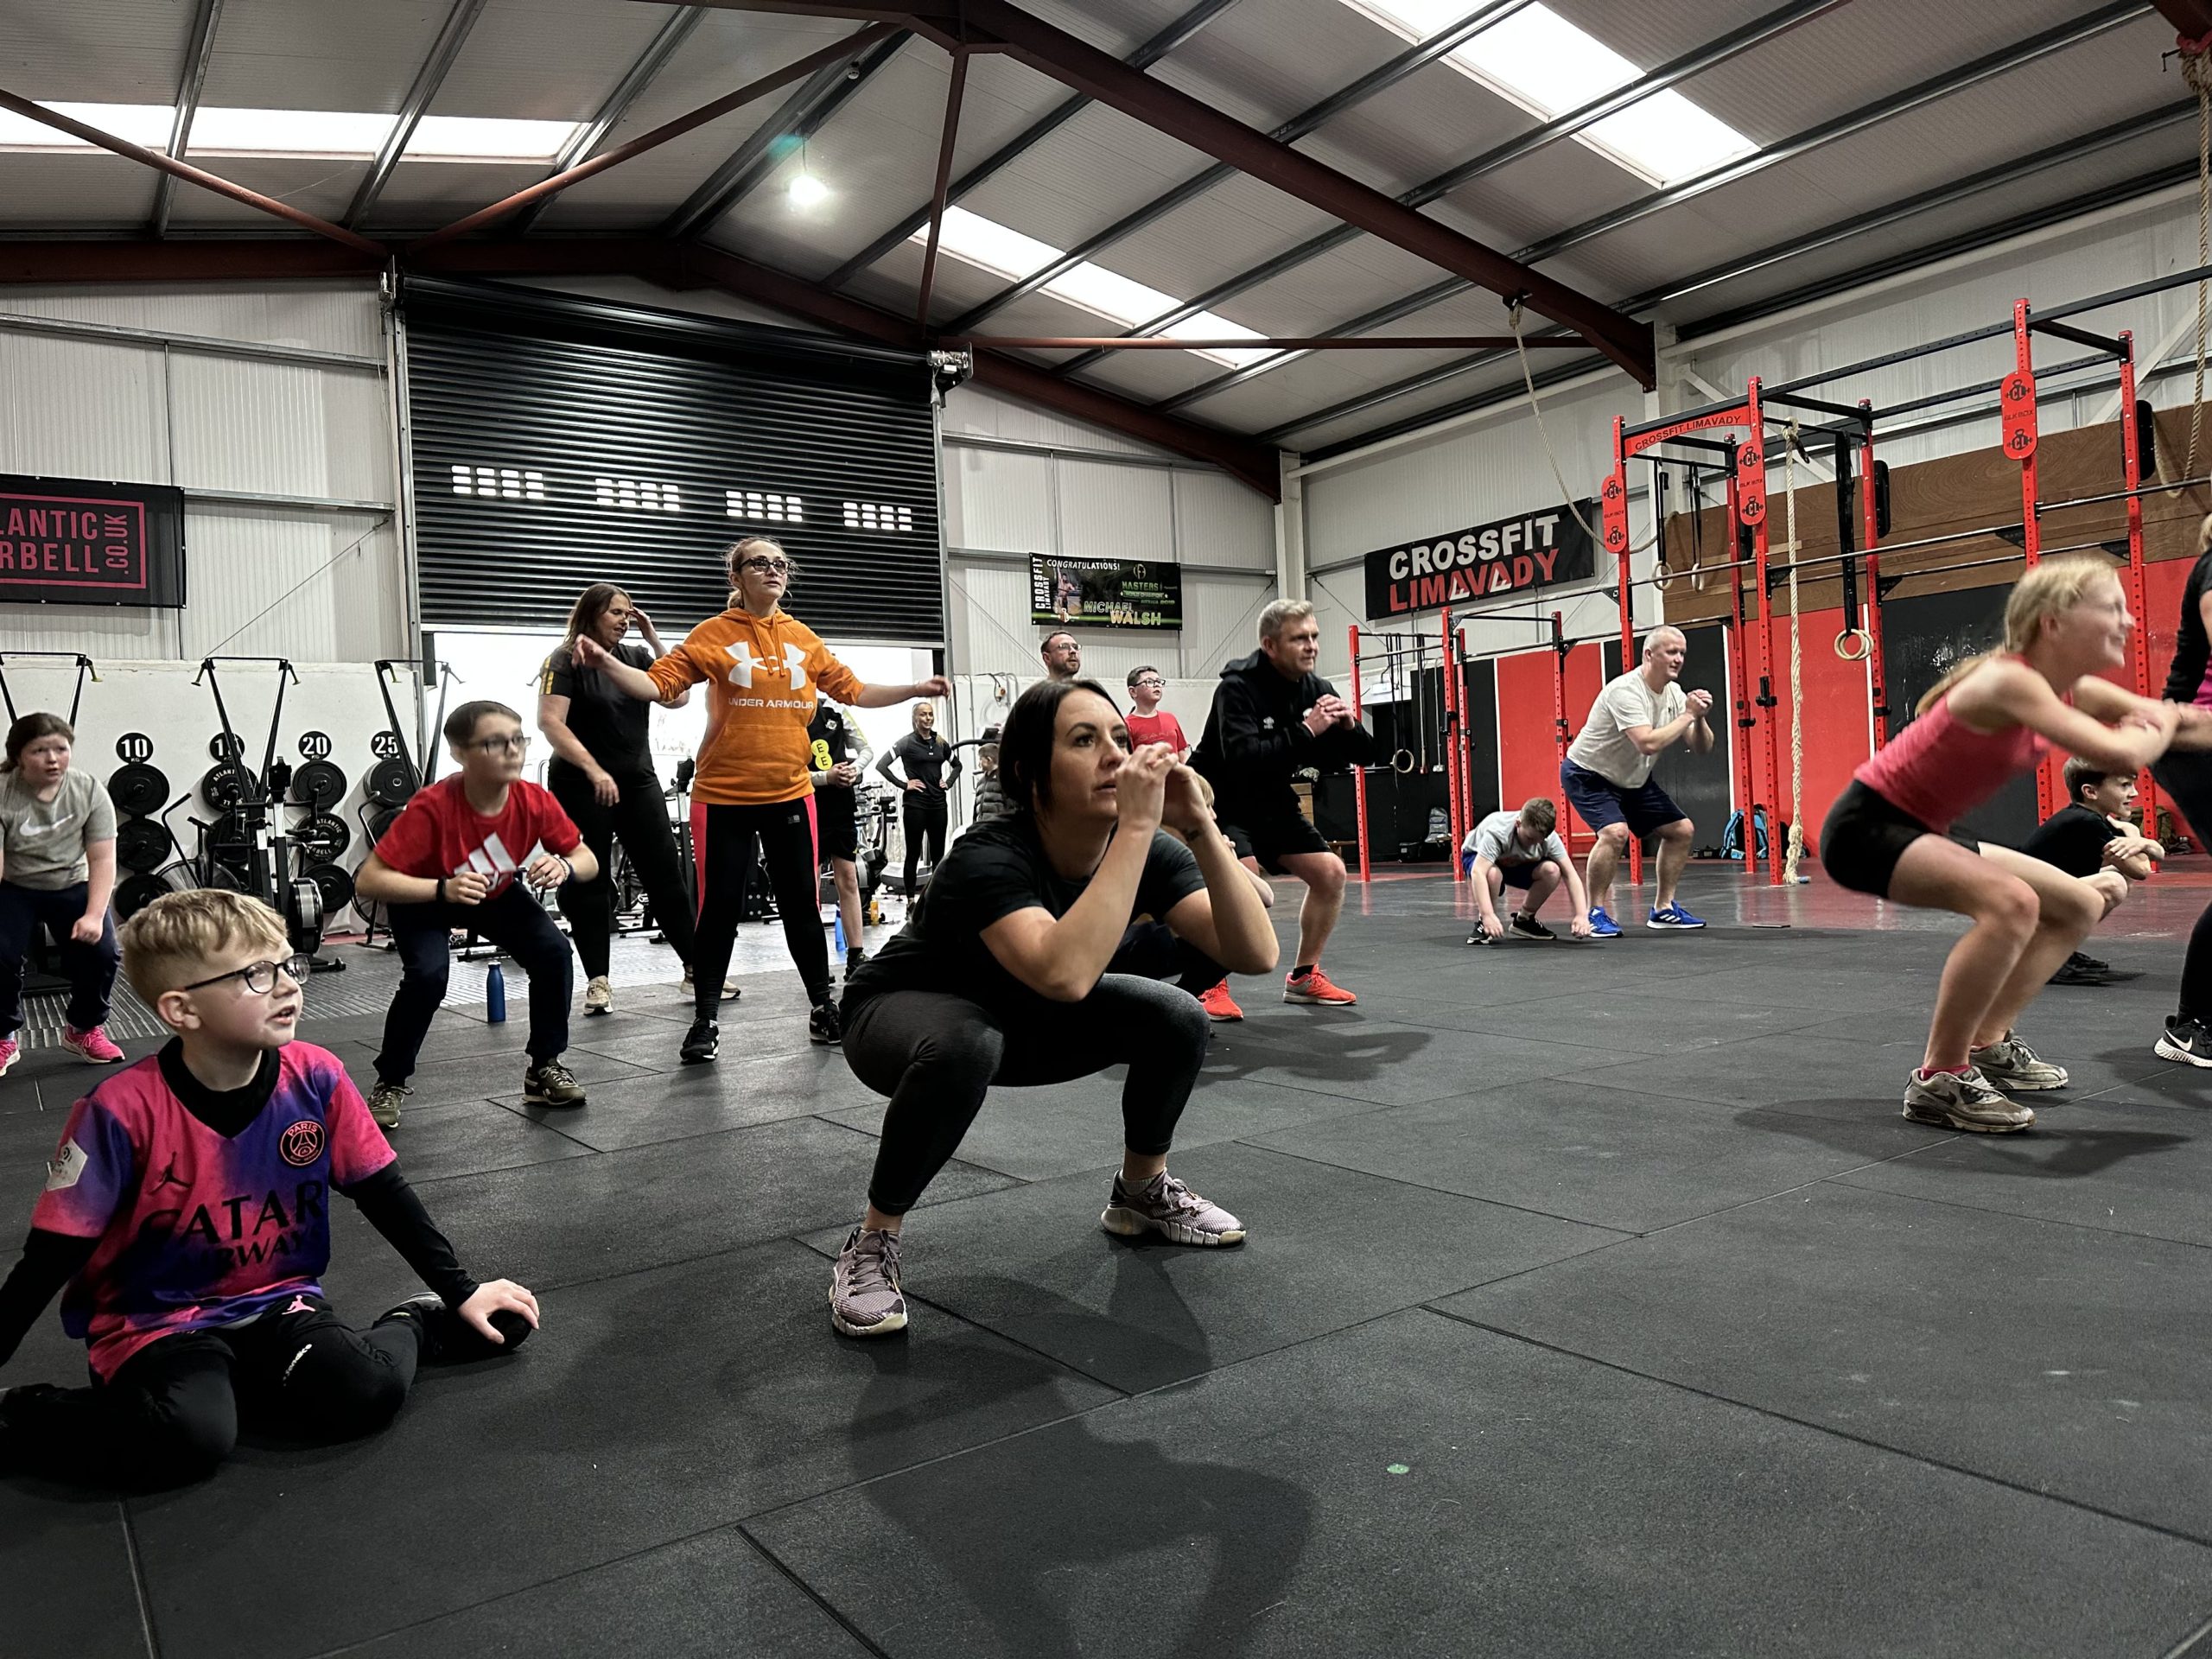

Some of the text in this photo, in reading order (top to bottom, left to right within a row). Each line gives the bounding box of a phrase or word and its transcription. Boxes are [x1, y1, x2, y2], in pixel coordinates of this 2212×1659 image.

[1635, 416, 1741, 450] CROSSFIT LIMAVADY
[0, 508, 98, 540] ANTIC
[105, 513, 129, 575] .CO.UK
[1389, 514, 1560, 580] CROSSFIT
[1046, 559, 1121, 570] CONGRATULATIONS!
[1033, 556, 1046, 609] CROSSFIT
[1122, 581, 1159, 592] MASTERS
[1389, 548, 1559, 612] LIMAVADY
[1042, 576, 1052, 609] LIMAVADY
[1083, 601, 1135, 613] MICHAEL
[1110, 610, 1161, 626] WALSH
[728, 697, 814, 709] UNDER ARMOUR
[121, 738, 148, 758] 10
[302, 736, 327, 755] 20
[374, 736, 398, 754] 25
[287, 1122, 318, 1137] PARIS
